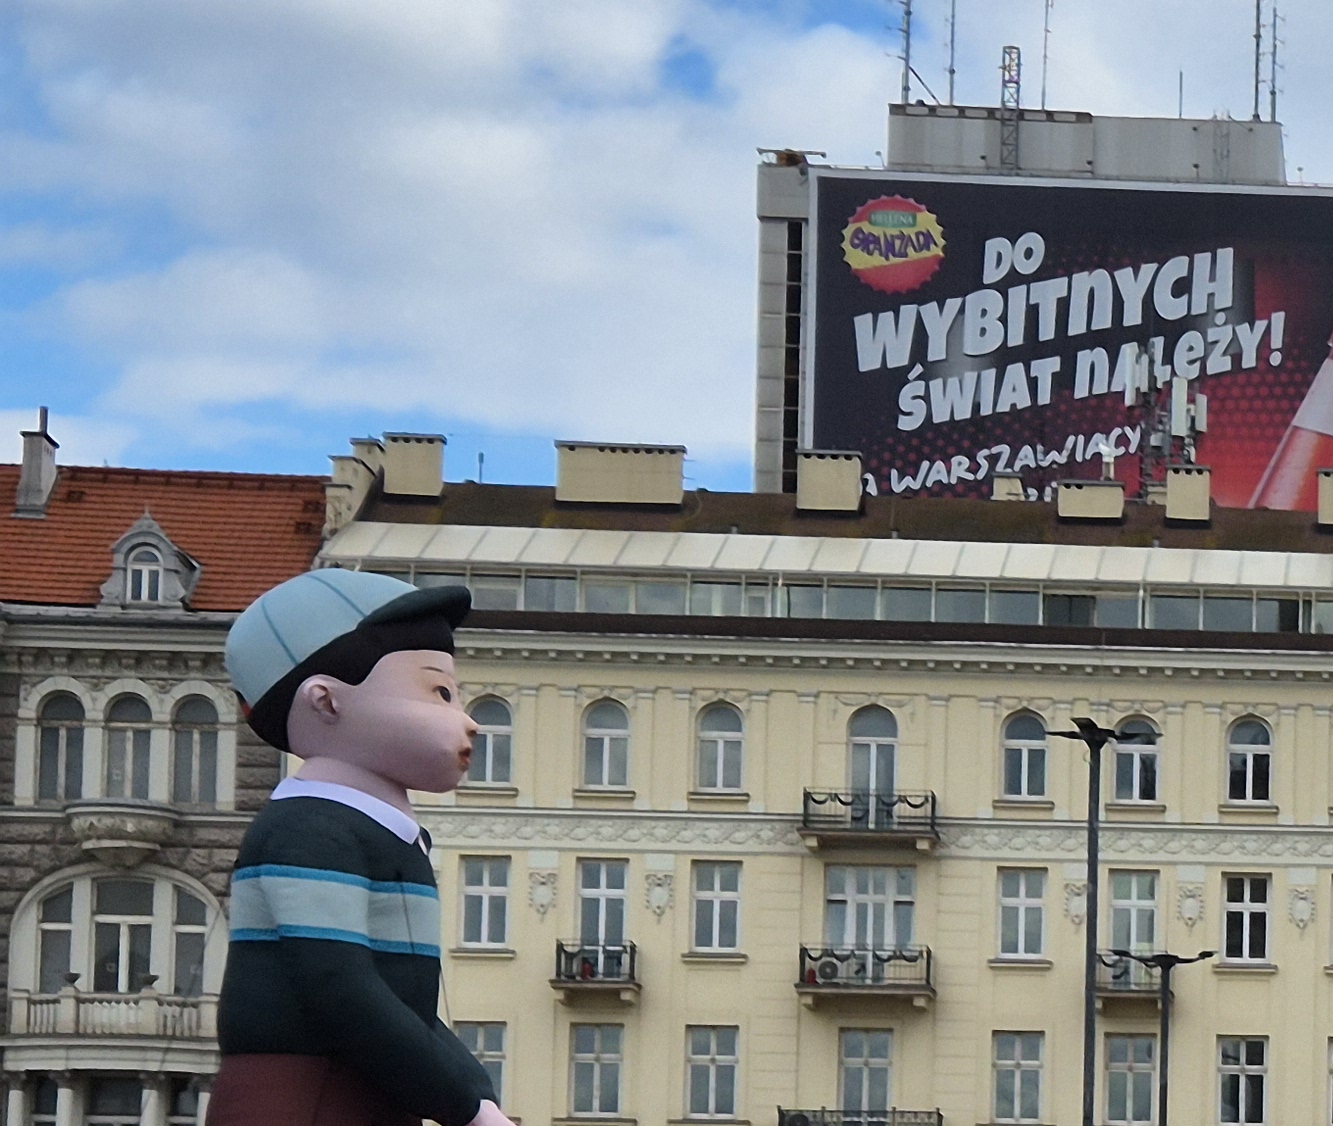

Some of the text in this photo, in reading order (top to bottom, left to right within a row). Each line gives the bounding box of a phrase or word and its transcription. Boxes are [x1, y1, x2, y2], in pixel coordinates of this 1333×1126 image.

[983, 232, 1046, 285] DO
[897, 356, 1061, 432] ŚWIAT
[890, 425, 1141, 494] WARSZAWIACY
